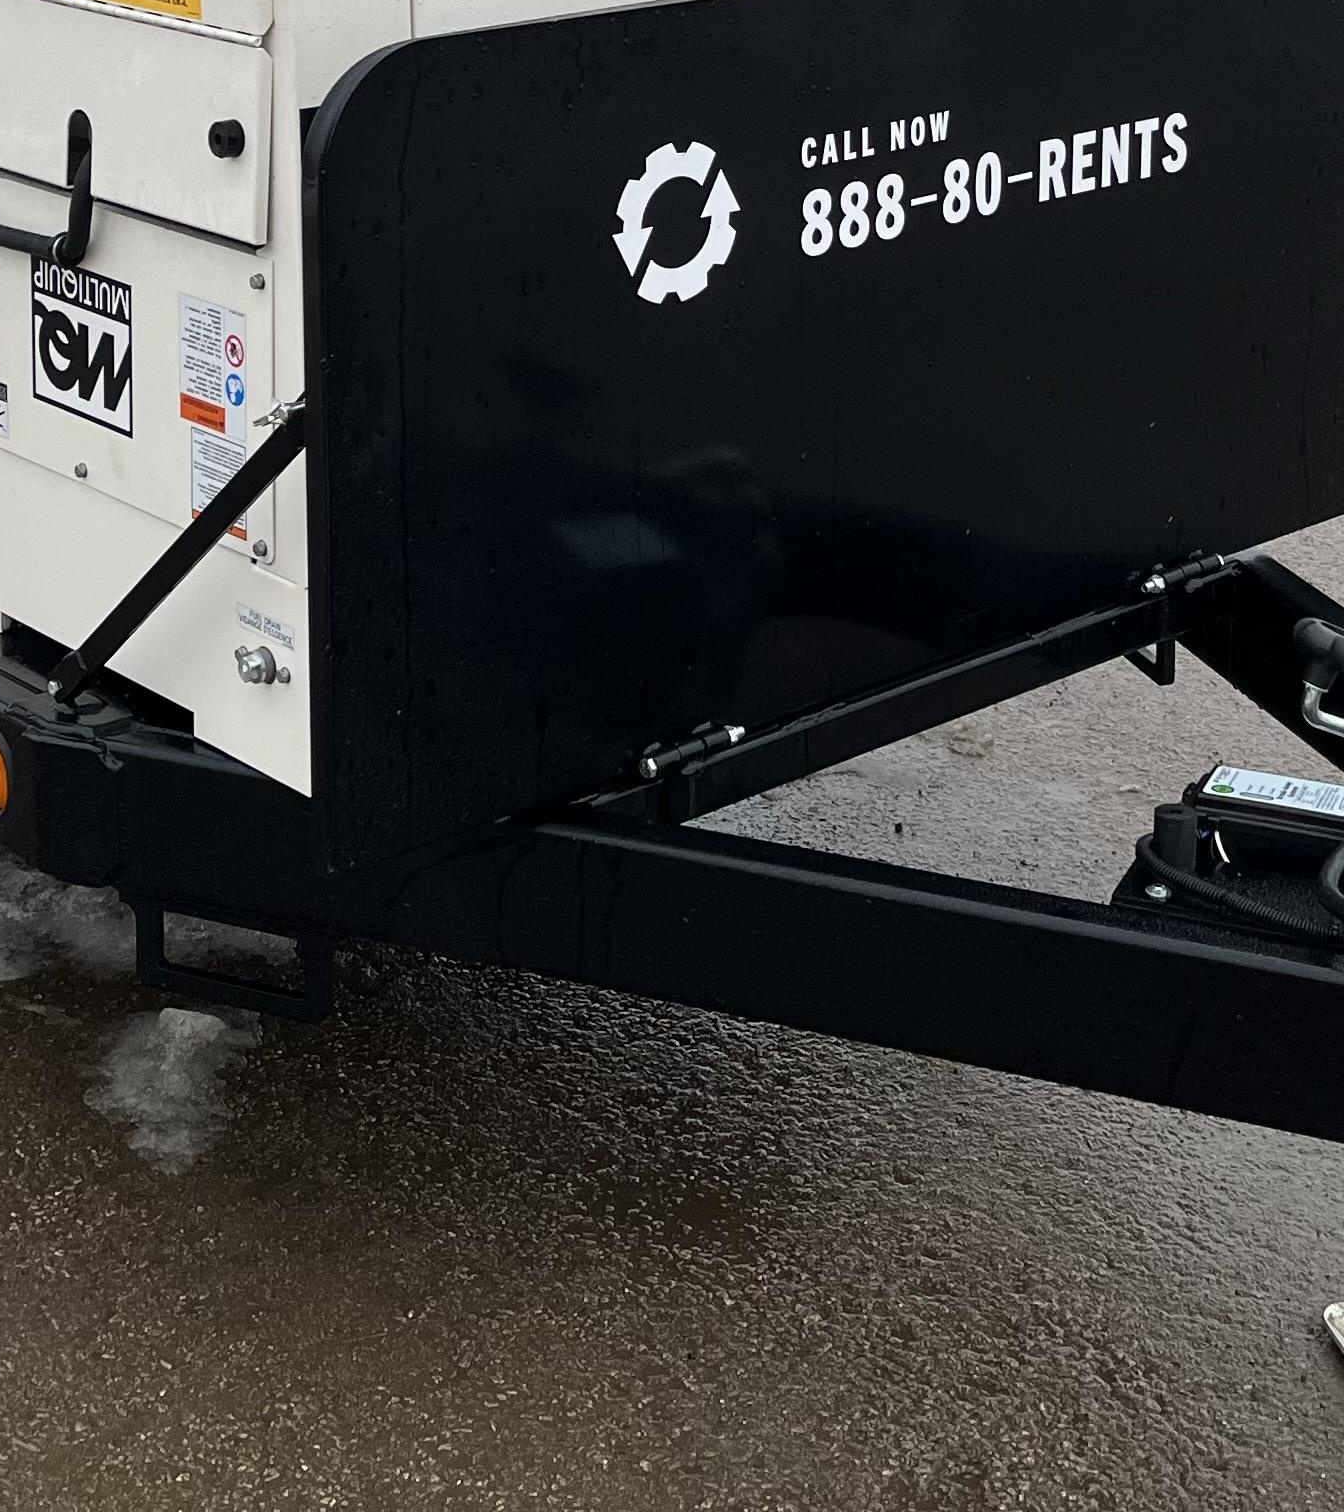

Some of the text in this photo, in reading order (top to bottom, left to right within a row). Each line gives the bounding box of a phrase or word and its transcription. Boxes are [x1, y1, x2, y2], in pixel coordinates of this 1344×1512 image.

[801, 110, 950, 169] CALL NOW
[800, 112, 1188, 257] 888-80-RENTS
[33, 259, 131, 321] MULTIQUIP
